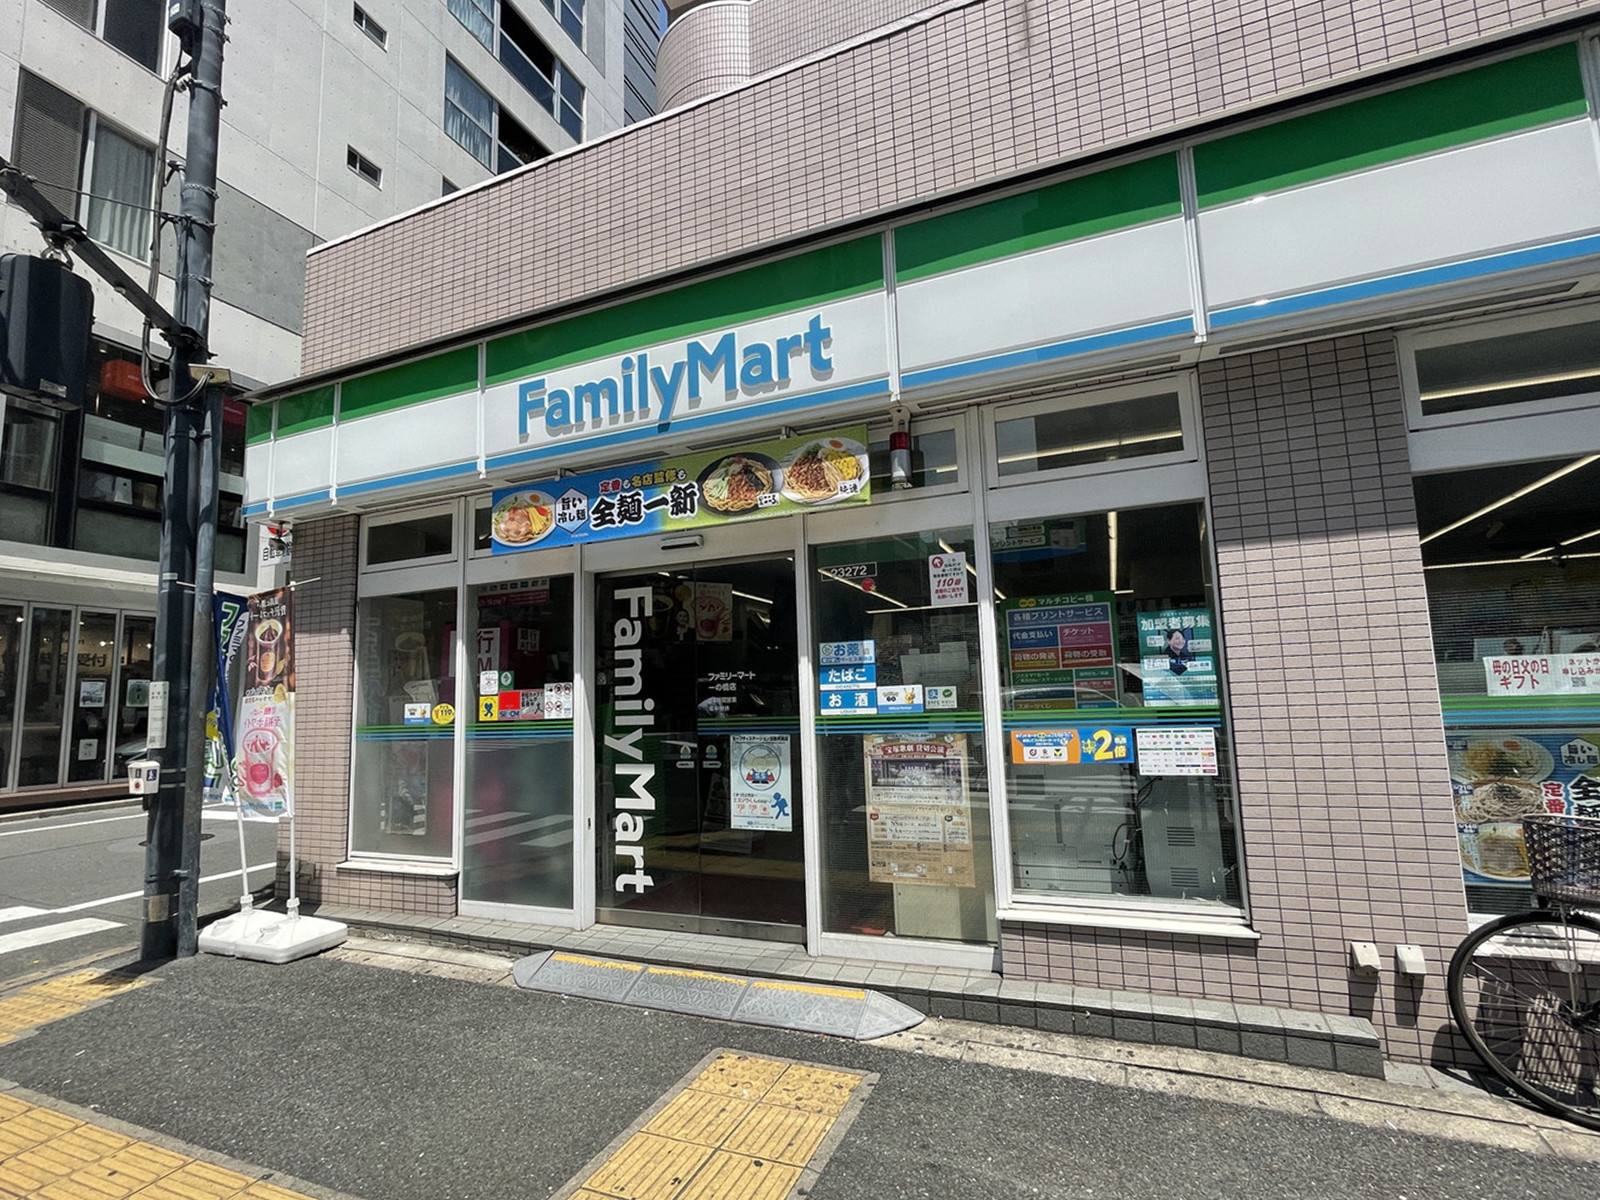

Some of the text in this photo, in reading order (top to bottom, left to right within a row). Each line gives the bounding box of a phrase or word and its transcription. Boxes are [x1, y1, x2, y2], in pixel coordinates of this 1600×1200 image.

[517, 313, 834, 440] FamilyMart
[561, 496, 583, 510] 旨い
[590, 481, 698, 529] 全麺一新
[557, 507, 588, 525] 冷し麺
[831, 565, 868, 579] 23272
[1013, 607, 1104, 622] 各種プリントサービス
[1140, 615, 1211, 631] 加盟者募集
[1062, 627, 1095, 638] チケット
[834, 644, 860, 657] お薬
[1492, 658, 1550, 675] 母の日父の日
[708, 671, 757, 681] ファミリーマート
[828, 668, 867, 682] たばこ
[1499, 674, 1540, 690] ギフト
[604, 586, 657, 894] FamilyMart
[1542, 781, 1566, 814] 定番
